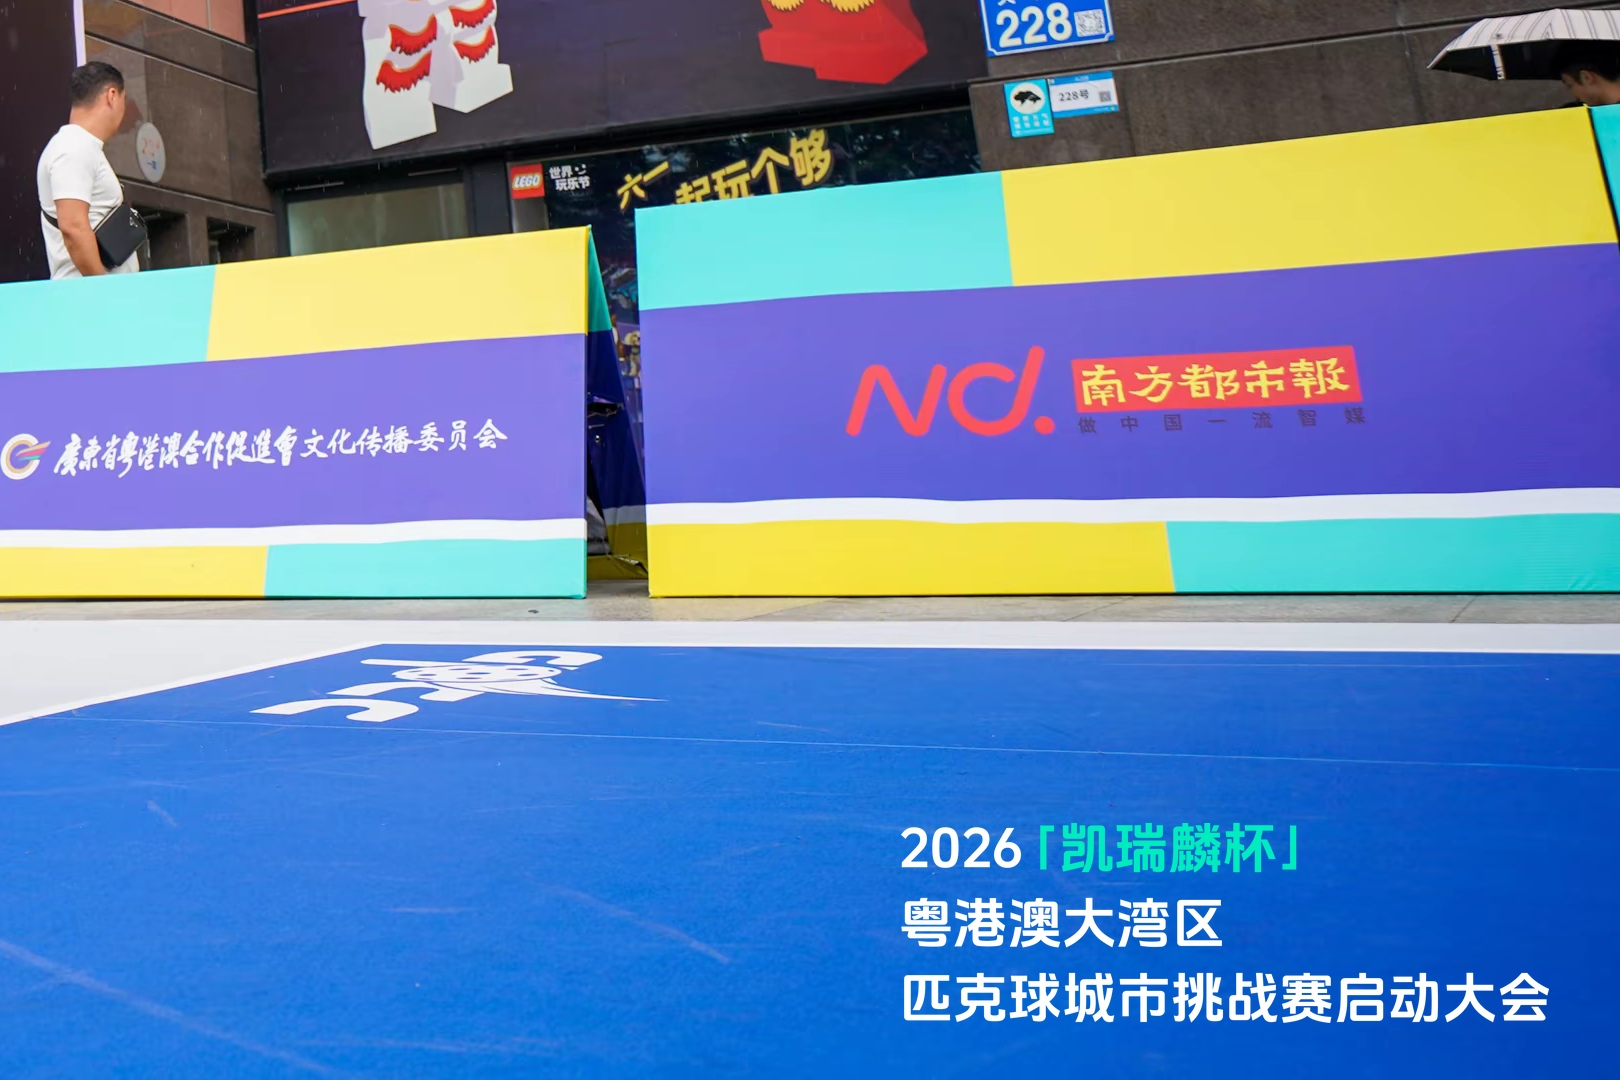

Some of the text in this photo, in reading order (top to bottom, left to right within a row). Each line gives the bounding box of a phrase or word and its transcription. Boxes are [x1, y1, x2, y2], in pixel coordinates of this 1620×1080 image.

[996, 2, 1073, 48] 228
[1059, 88, 1089, 102] 228号
[549, 165, 573, 179] 世界
[513, 174, 541, 189] LEGO
[555, 175, 590, 191] 玩乐节
[1080, 357, 1350, 406] 南方都市報
[1078, 406, 1366, 434] 做中国一流智媒
